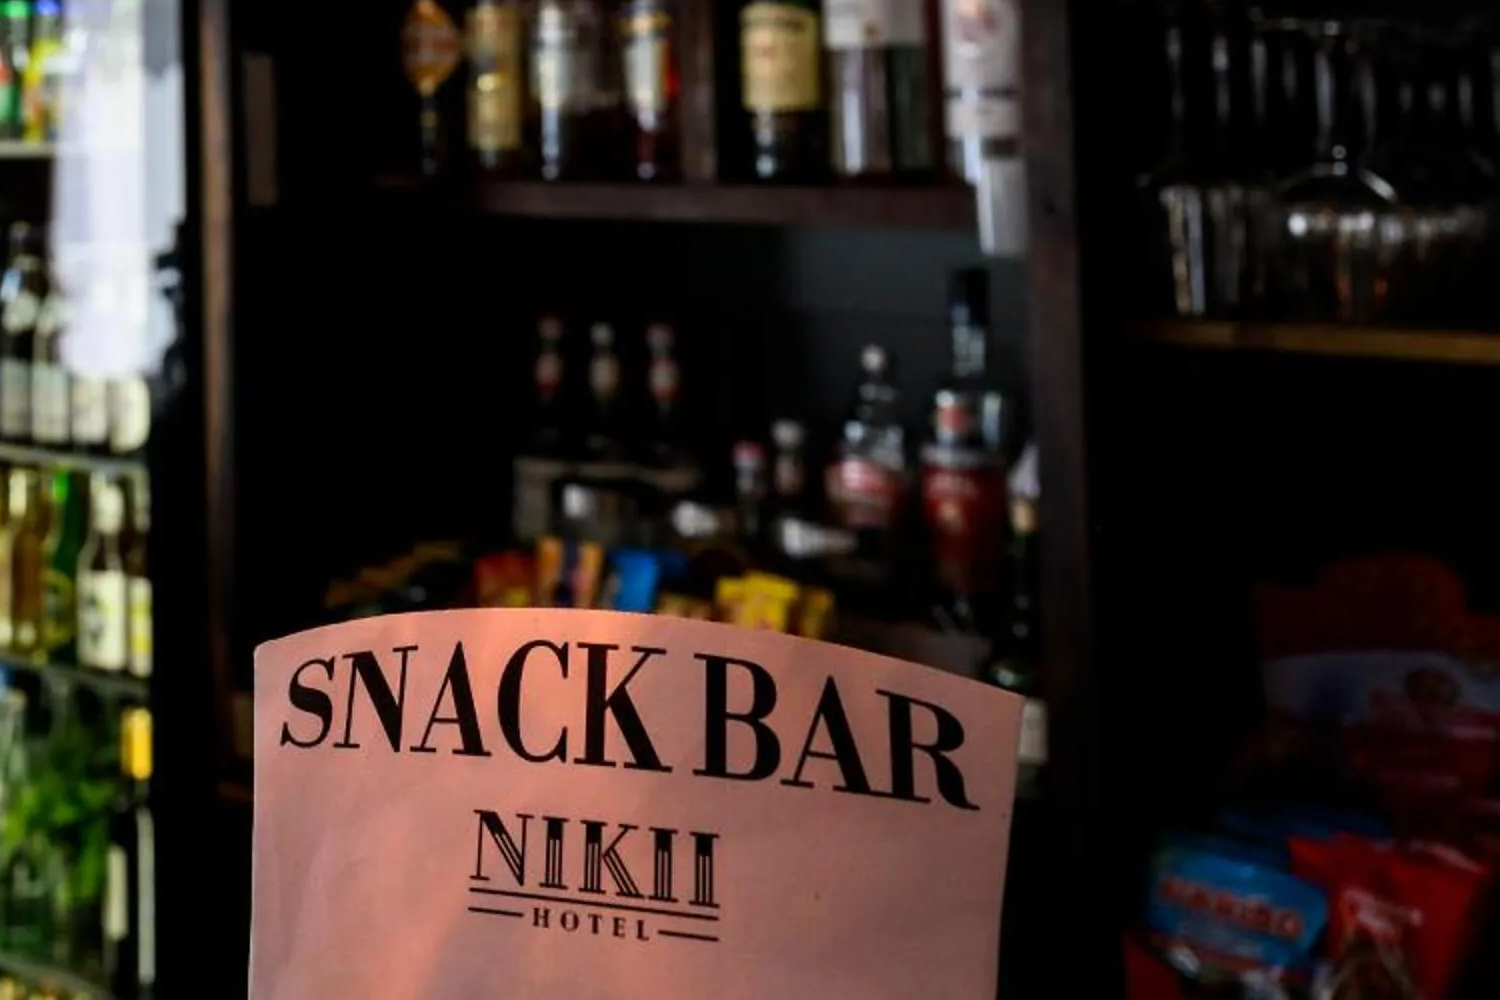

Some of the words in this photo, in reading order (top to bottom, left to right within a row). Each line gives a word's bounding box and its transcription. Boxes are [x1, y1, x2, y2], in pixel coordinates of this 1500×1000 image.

[280, 640, 673, 774] SNACK
[693, 653, 982, 812] BAR
[469, 809, 721, 909] NIKII
[532, 907, 650, 942] HOTEL
